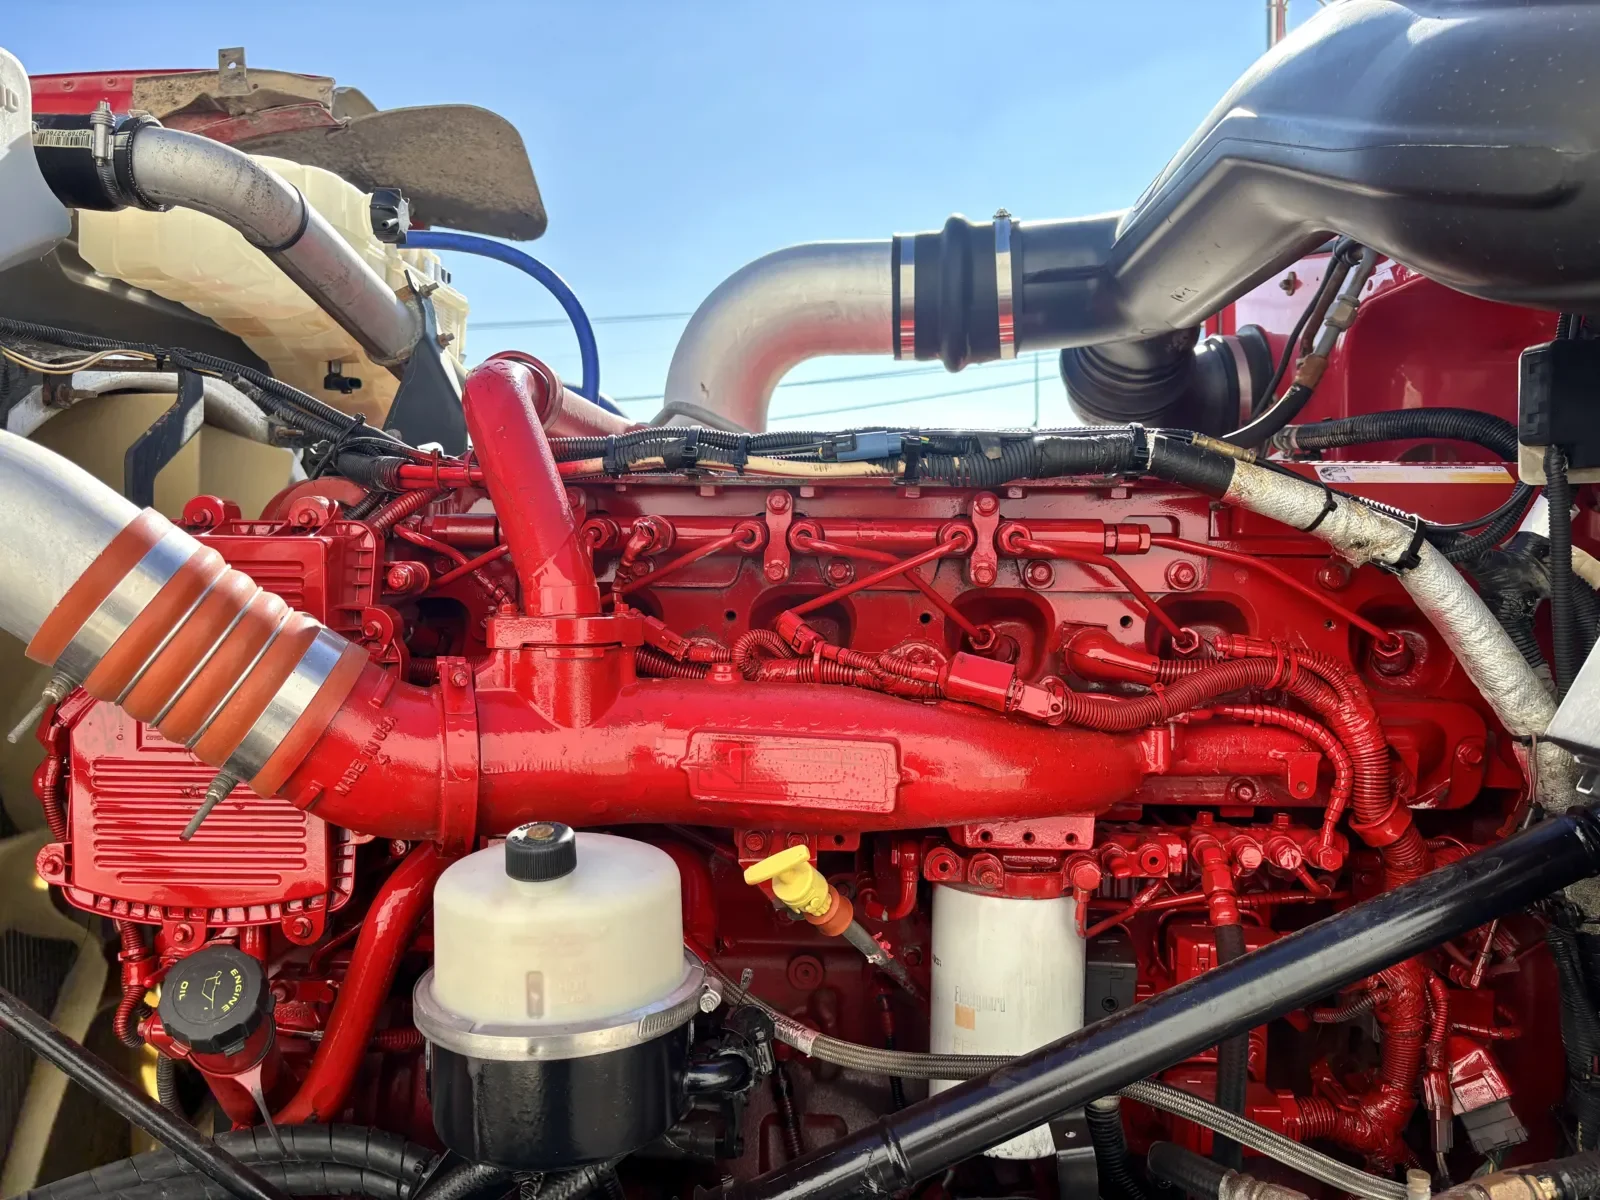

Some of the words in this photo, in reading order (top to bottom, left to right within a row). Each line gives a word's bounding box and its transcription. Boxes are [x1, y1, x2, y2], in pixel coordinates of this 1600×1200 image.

[333, 758, 368, 797] MADE
[360, 740, 382, 760] IN
[374, 716, 399, 742] USA
[178, 980, 189, 1001] OIL
[221, 968, 242, 1012] ENGINE
